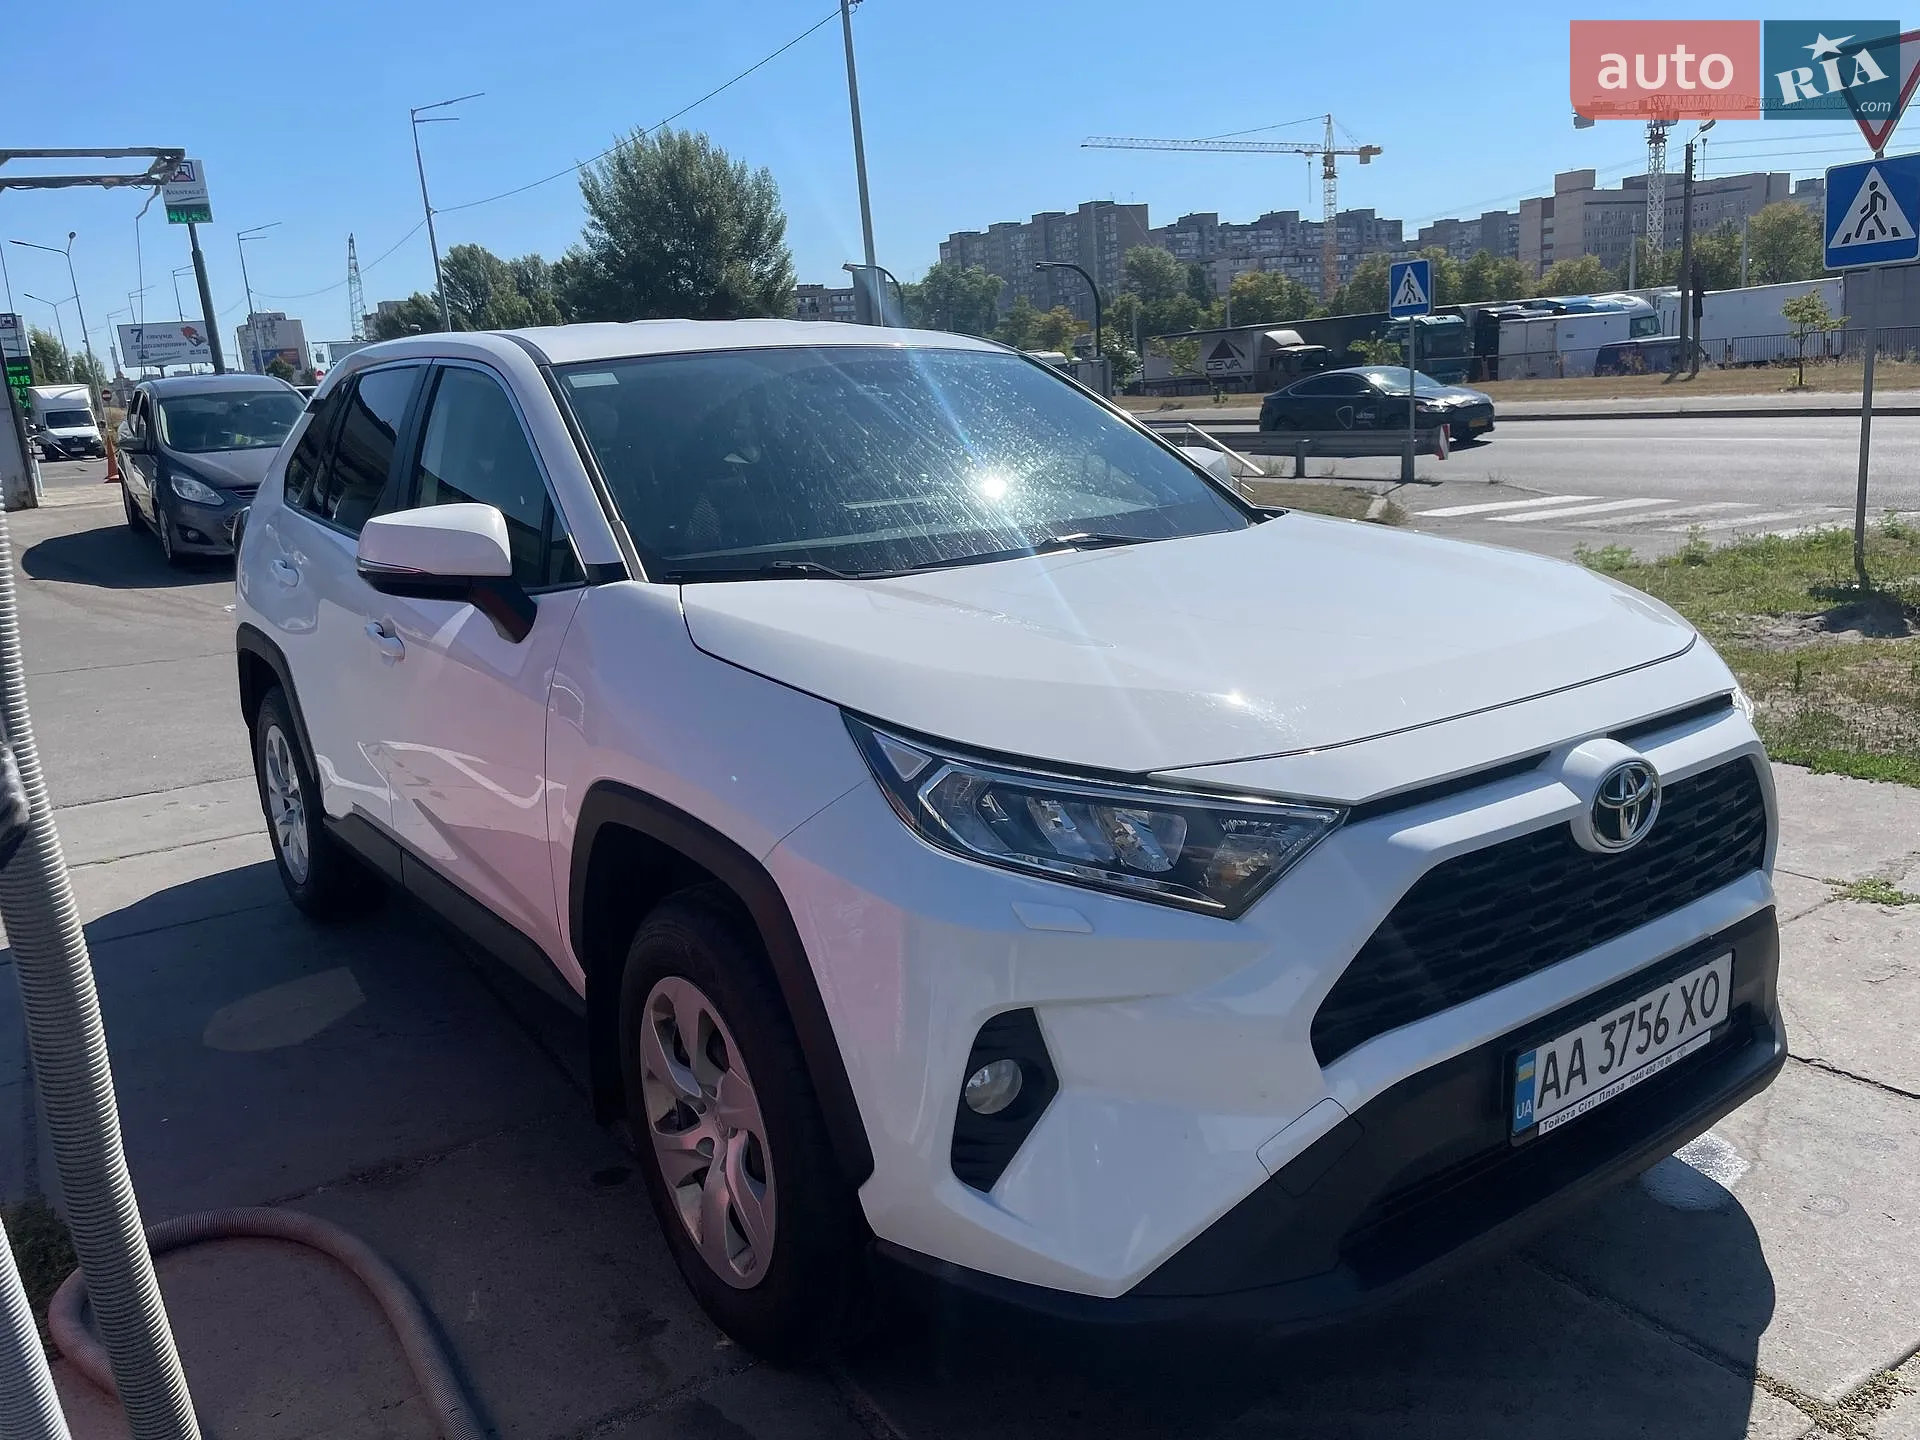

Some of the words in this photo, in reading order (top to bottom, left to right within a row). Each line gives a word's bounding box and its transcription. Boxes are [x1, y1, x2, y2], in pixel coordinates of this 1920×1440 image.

[130, 328, 143, 343] 7
[1206, 359, 1242, 371] CEVA
[1537, 1037, 1587, 1109] AA
[1598, 993, 1670, 1075] 3756
[1678, 970, 1720, 1035] XO
[1516, 1100, 1532, 1119] UA
[1543, 1109, 1576, 1131] Тойота
[1599, 1083, 1625, 1102] Плаза
